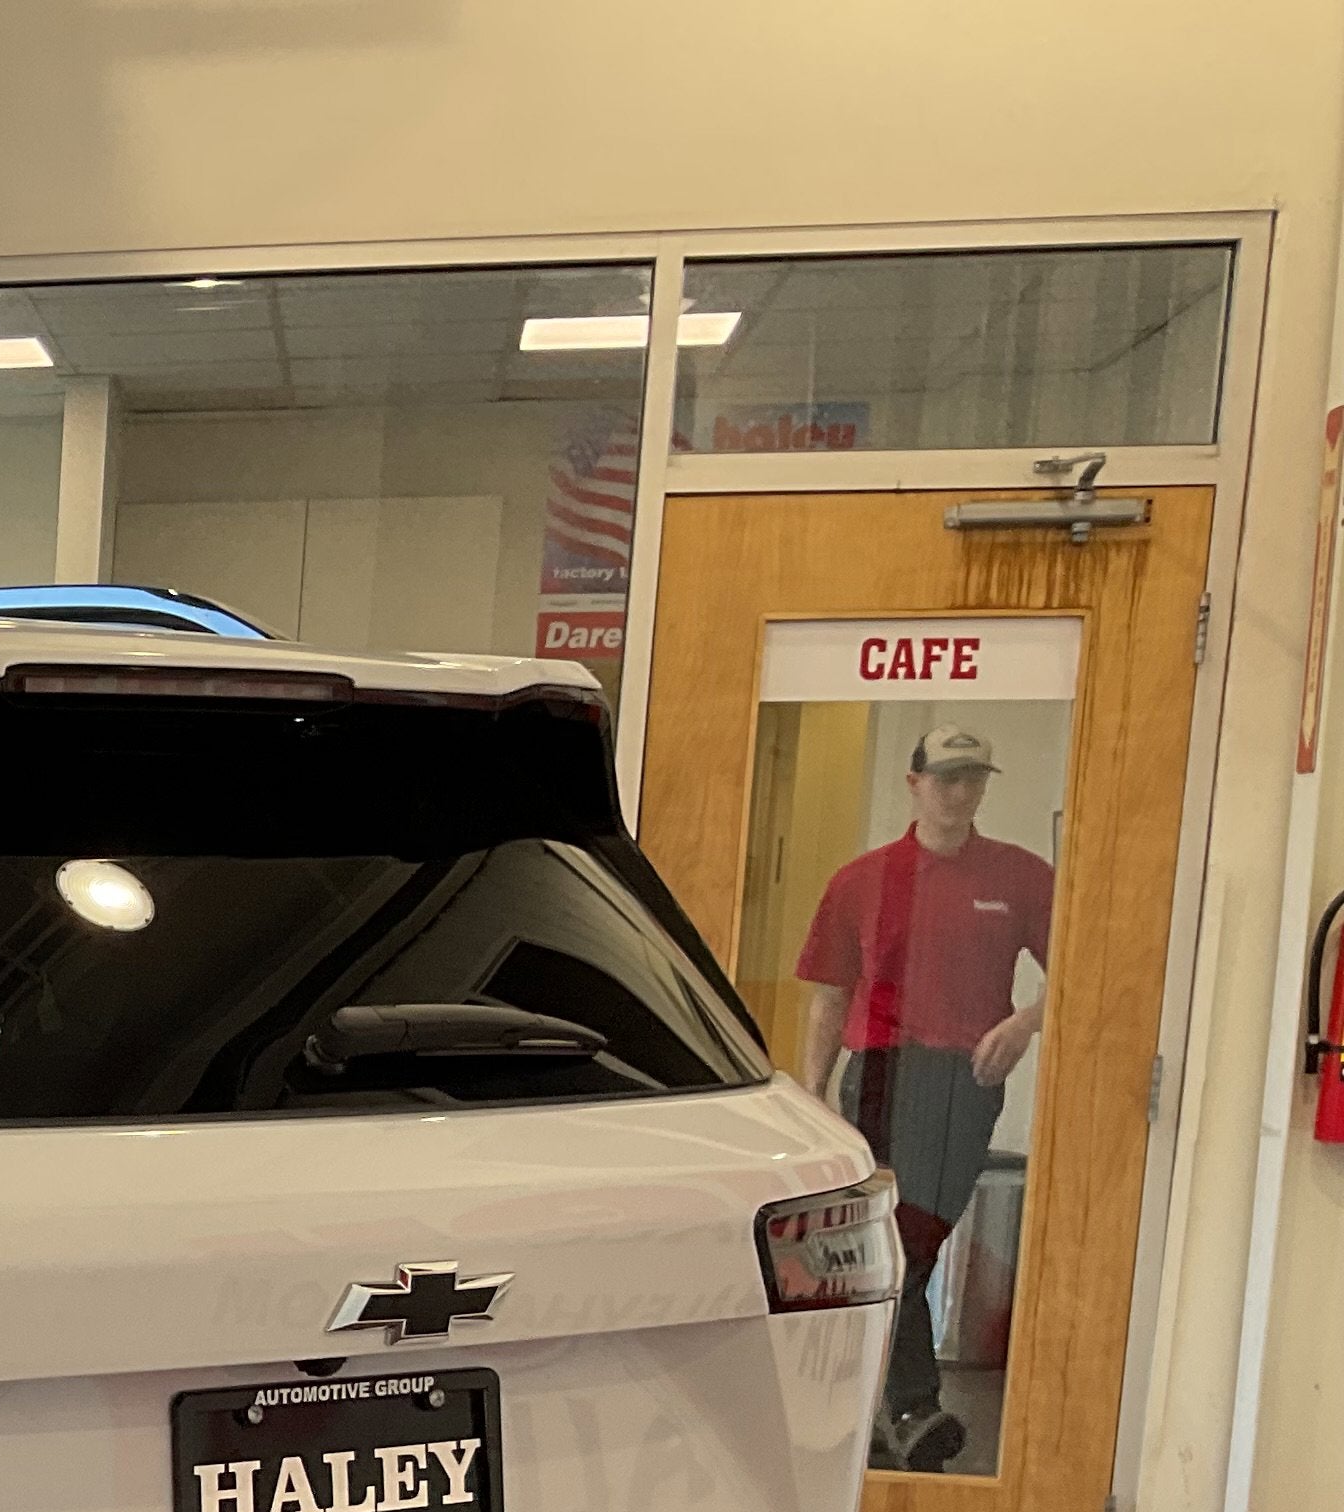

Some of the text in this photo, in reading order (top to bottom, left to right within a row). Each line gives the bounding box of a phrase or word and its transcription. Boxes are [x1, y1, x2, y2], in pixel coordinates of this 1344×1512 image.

[544, 620, 622, 649] Dare
[859, 637, 980, 681] CAFE
[254, 1375, 435, 1406] AUTOMOTIVE GROUP
